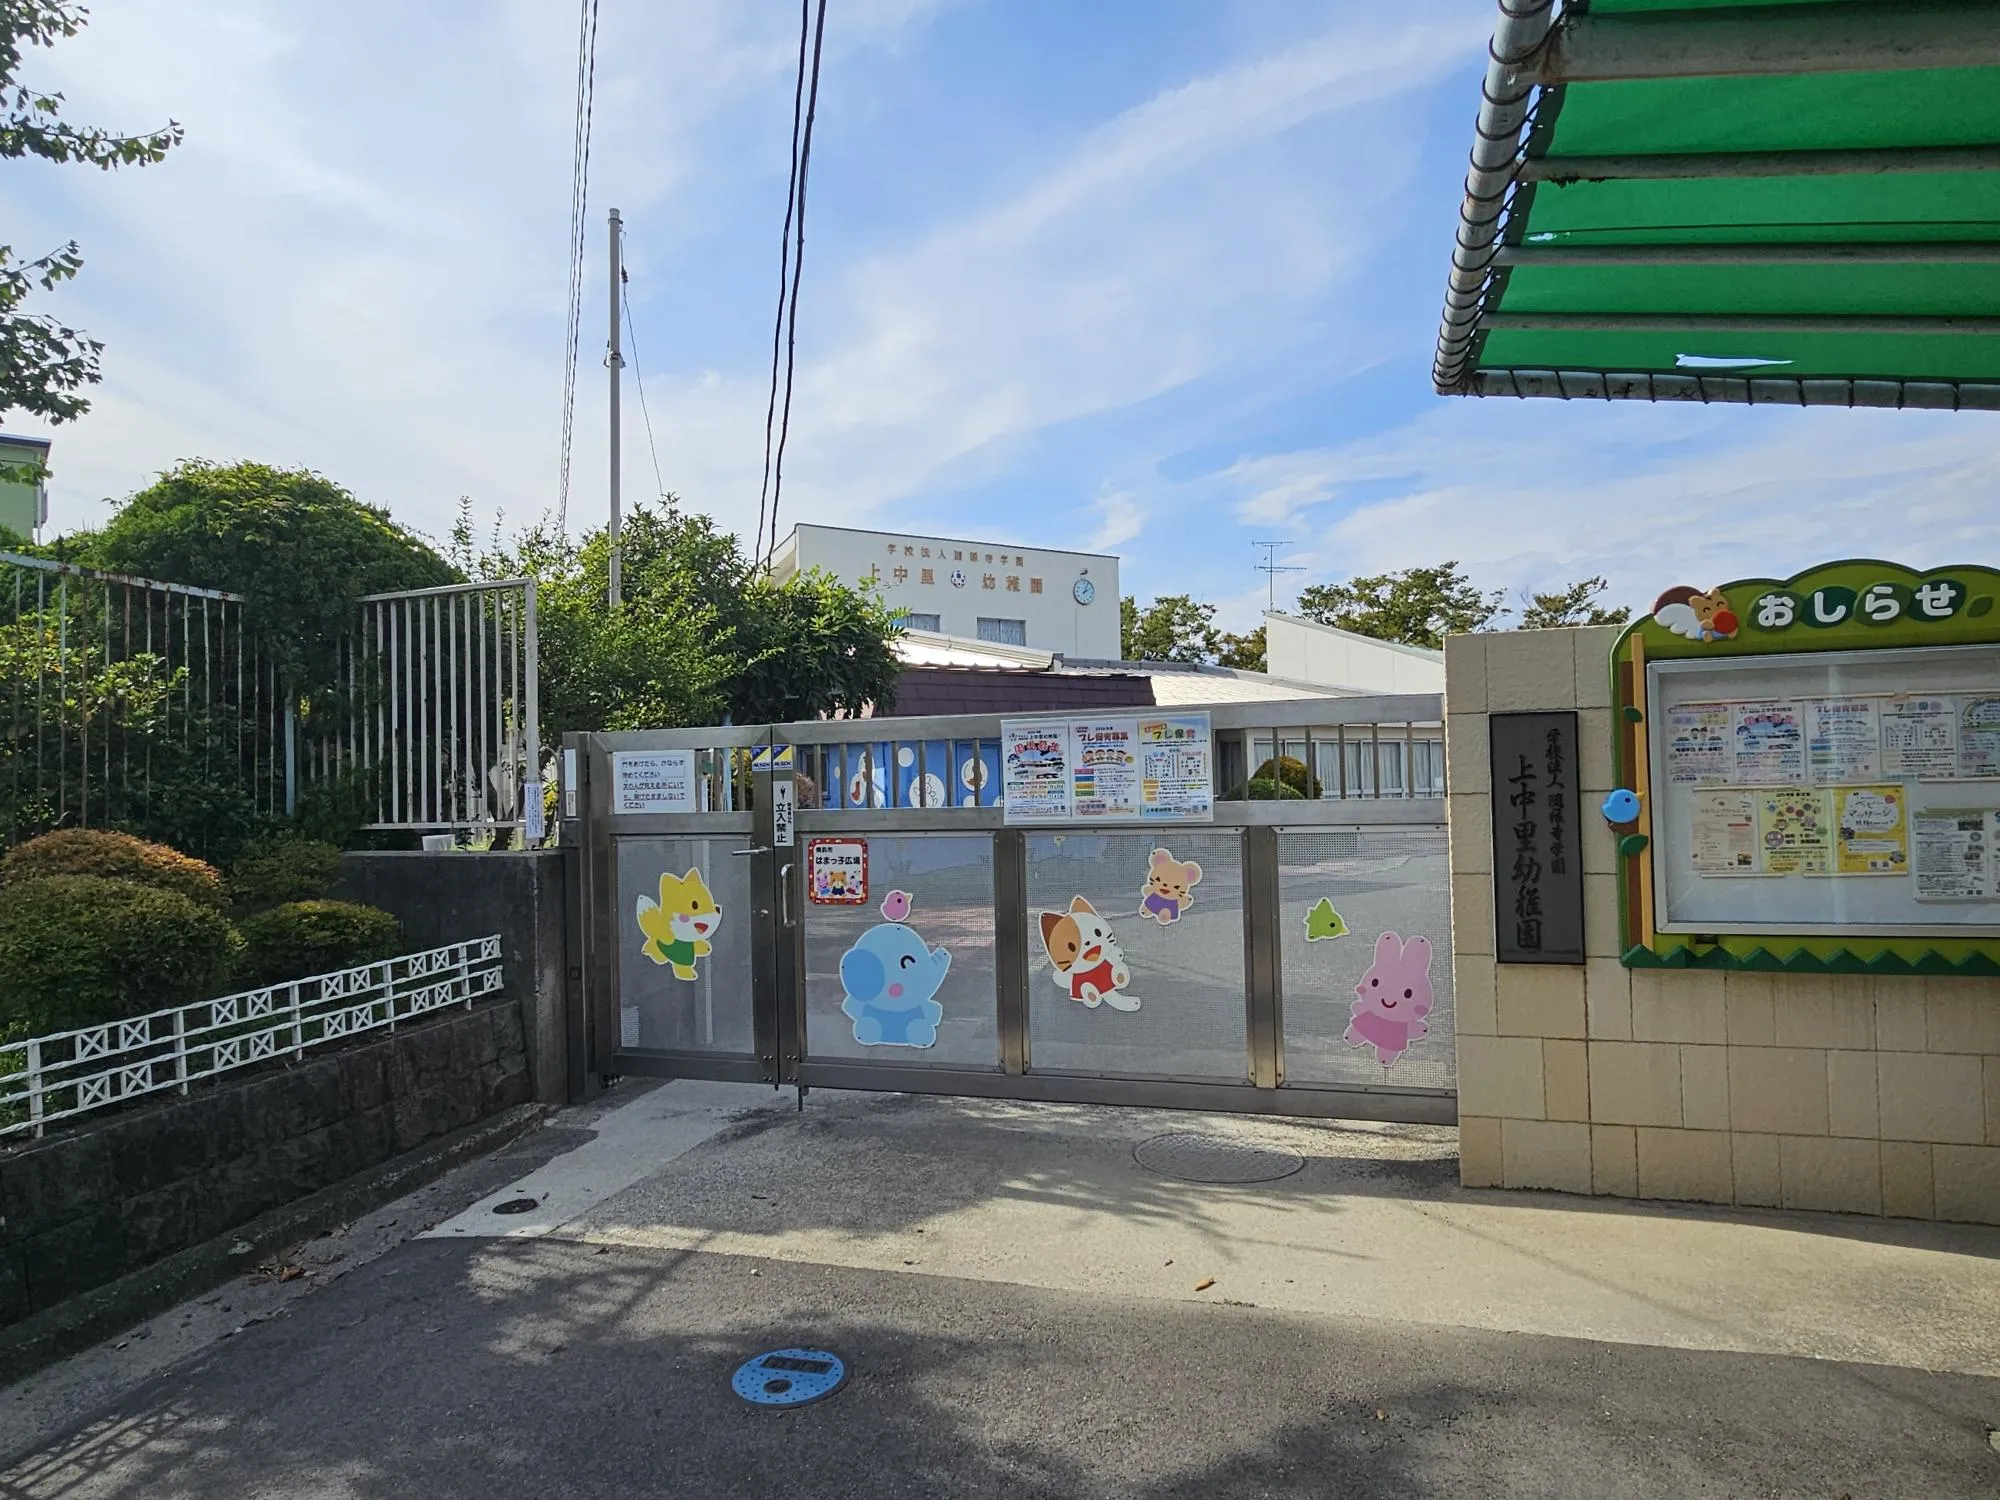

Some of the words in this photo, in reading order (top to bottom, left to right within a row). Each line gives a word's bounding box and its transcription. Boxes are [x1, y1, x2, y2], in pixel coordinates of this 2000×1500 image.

[1757, 583, 1957, 627] おしらせ
[775, 802, 788, 844] 立入禁止
[815, 856, 861, 865] はまっ子広場
[1508, 754, 1543, 951] 上中里幼稚園
